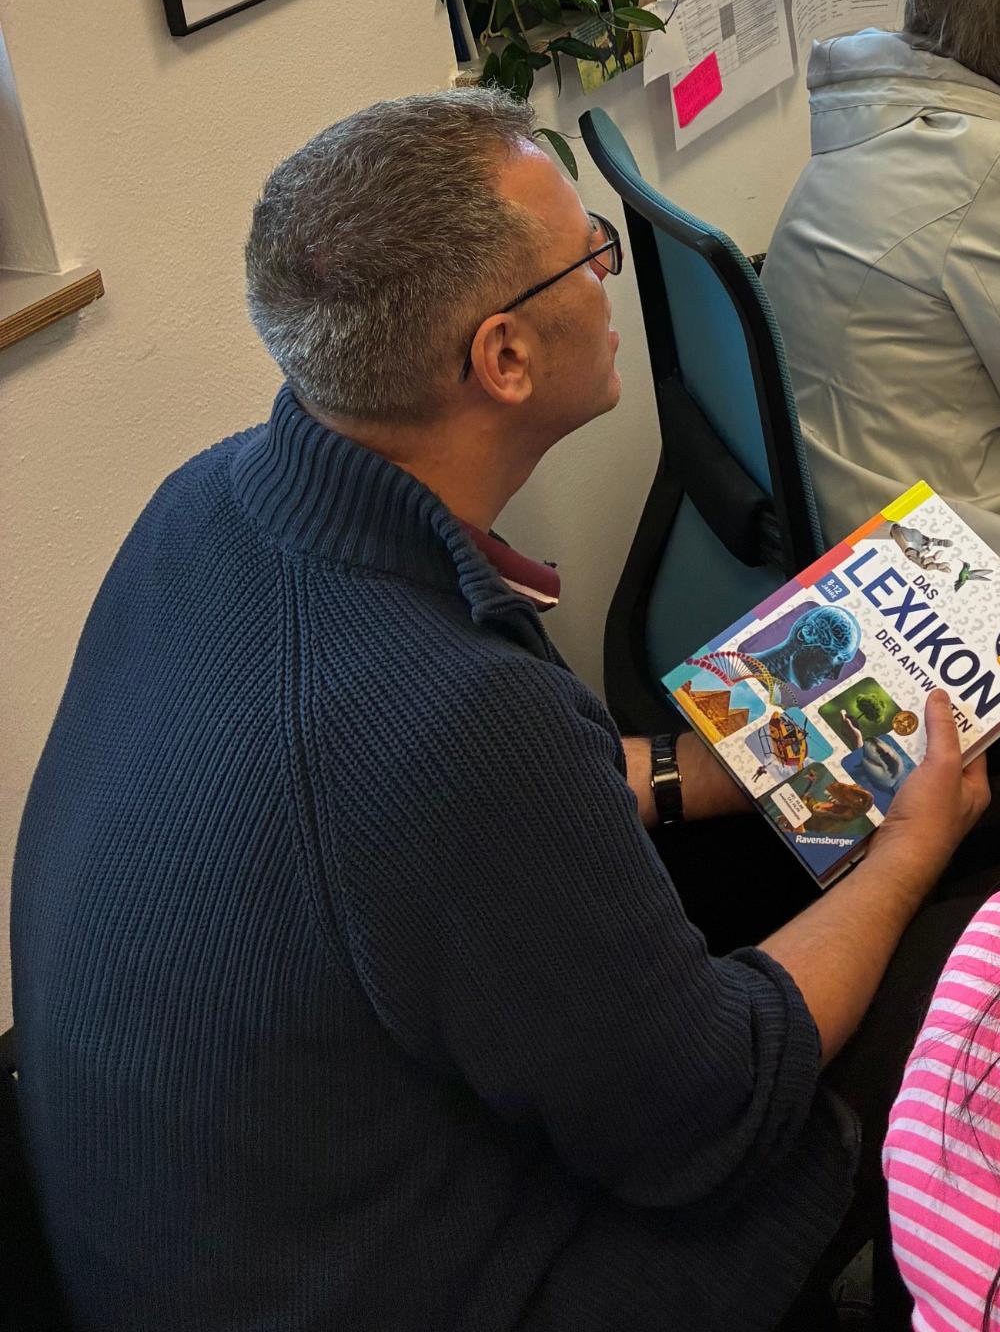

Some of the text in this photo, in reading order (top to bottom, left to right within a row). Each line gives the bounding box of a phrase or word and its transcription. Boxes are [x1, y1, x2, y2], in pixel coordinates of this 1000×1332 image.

[820, 583, 838, 600] JAHRE
[826, 578, 843, 595] 8-12
[912, 574, 939, 601] DAS
[875, 629, 973, 734] DER ANTWTEN
[795, 834, 855, 848] Ravensburger
